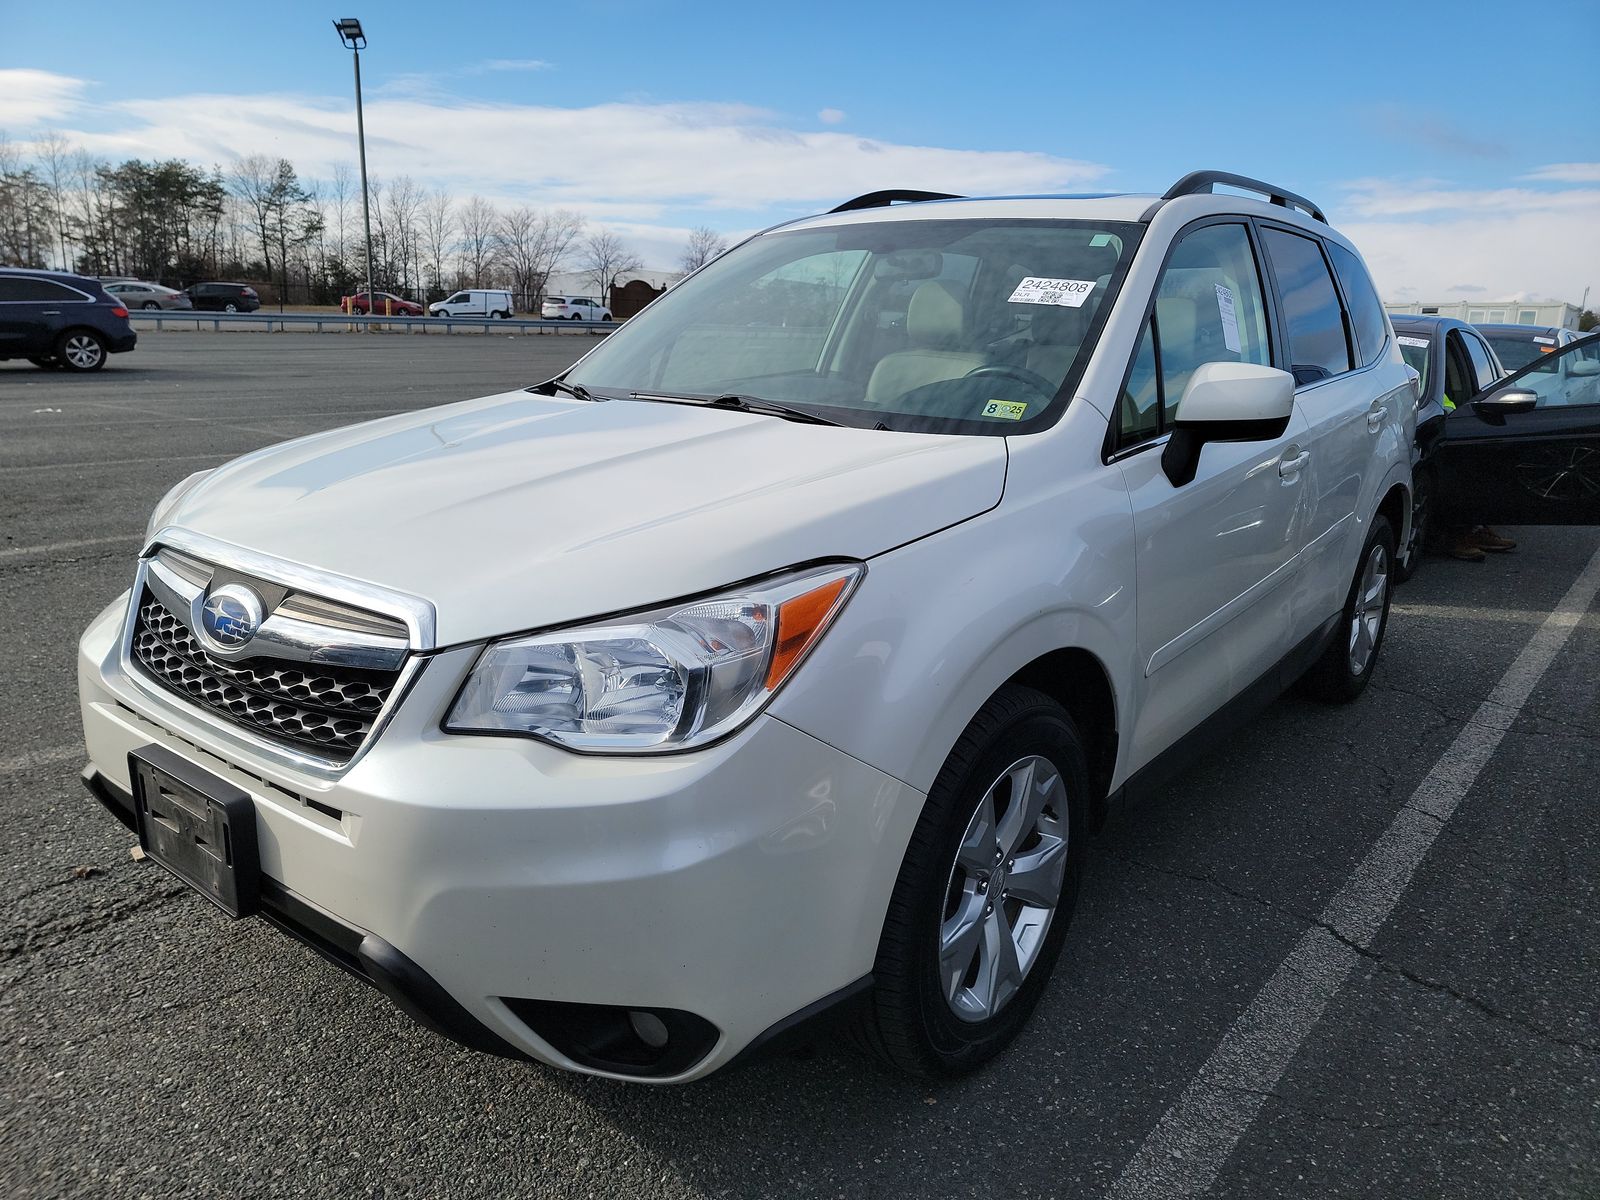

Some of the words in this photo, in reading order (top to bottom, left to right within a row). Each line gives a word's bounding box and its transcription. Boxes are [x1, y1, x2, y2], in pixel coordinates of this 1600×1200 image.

[1022, 280, 1089, 293] 2424808
[987, 404, 998, 413] 8
[1010, 405, 1023, 414] 25
